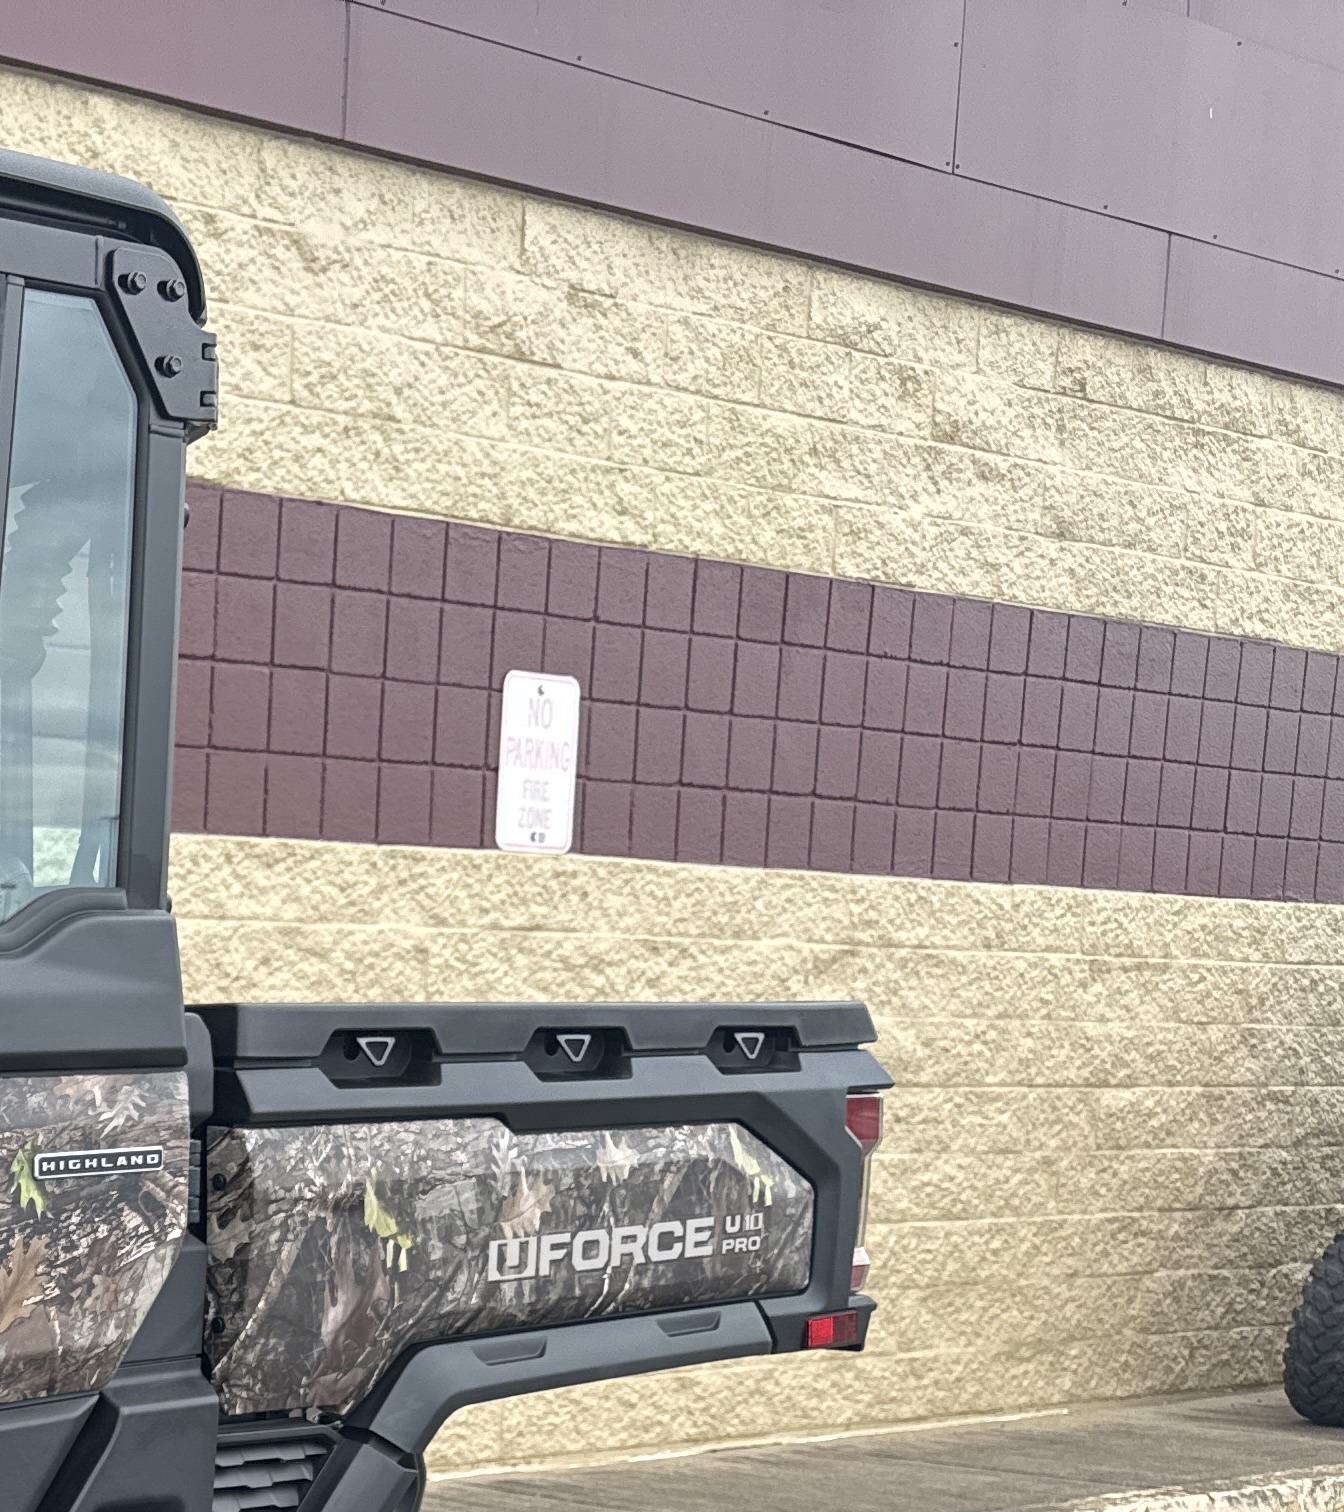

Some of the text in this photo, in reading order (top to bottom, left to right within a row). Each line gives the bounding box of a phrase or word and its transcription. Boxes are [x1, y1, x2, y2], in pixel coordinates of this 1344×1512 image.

[527, 697, 554, 730] NO
[504, 736, 572, 772] PARKING
[521, 778, 551, 802] FIRE
[517, 806, 552, 830] ZONE
[41, 1153, 160, 1172] HIGHLAND
[487, 1216, 715, 1282] UFORCE
[721, 1236, 761, 1255] PRO
